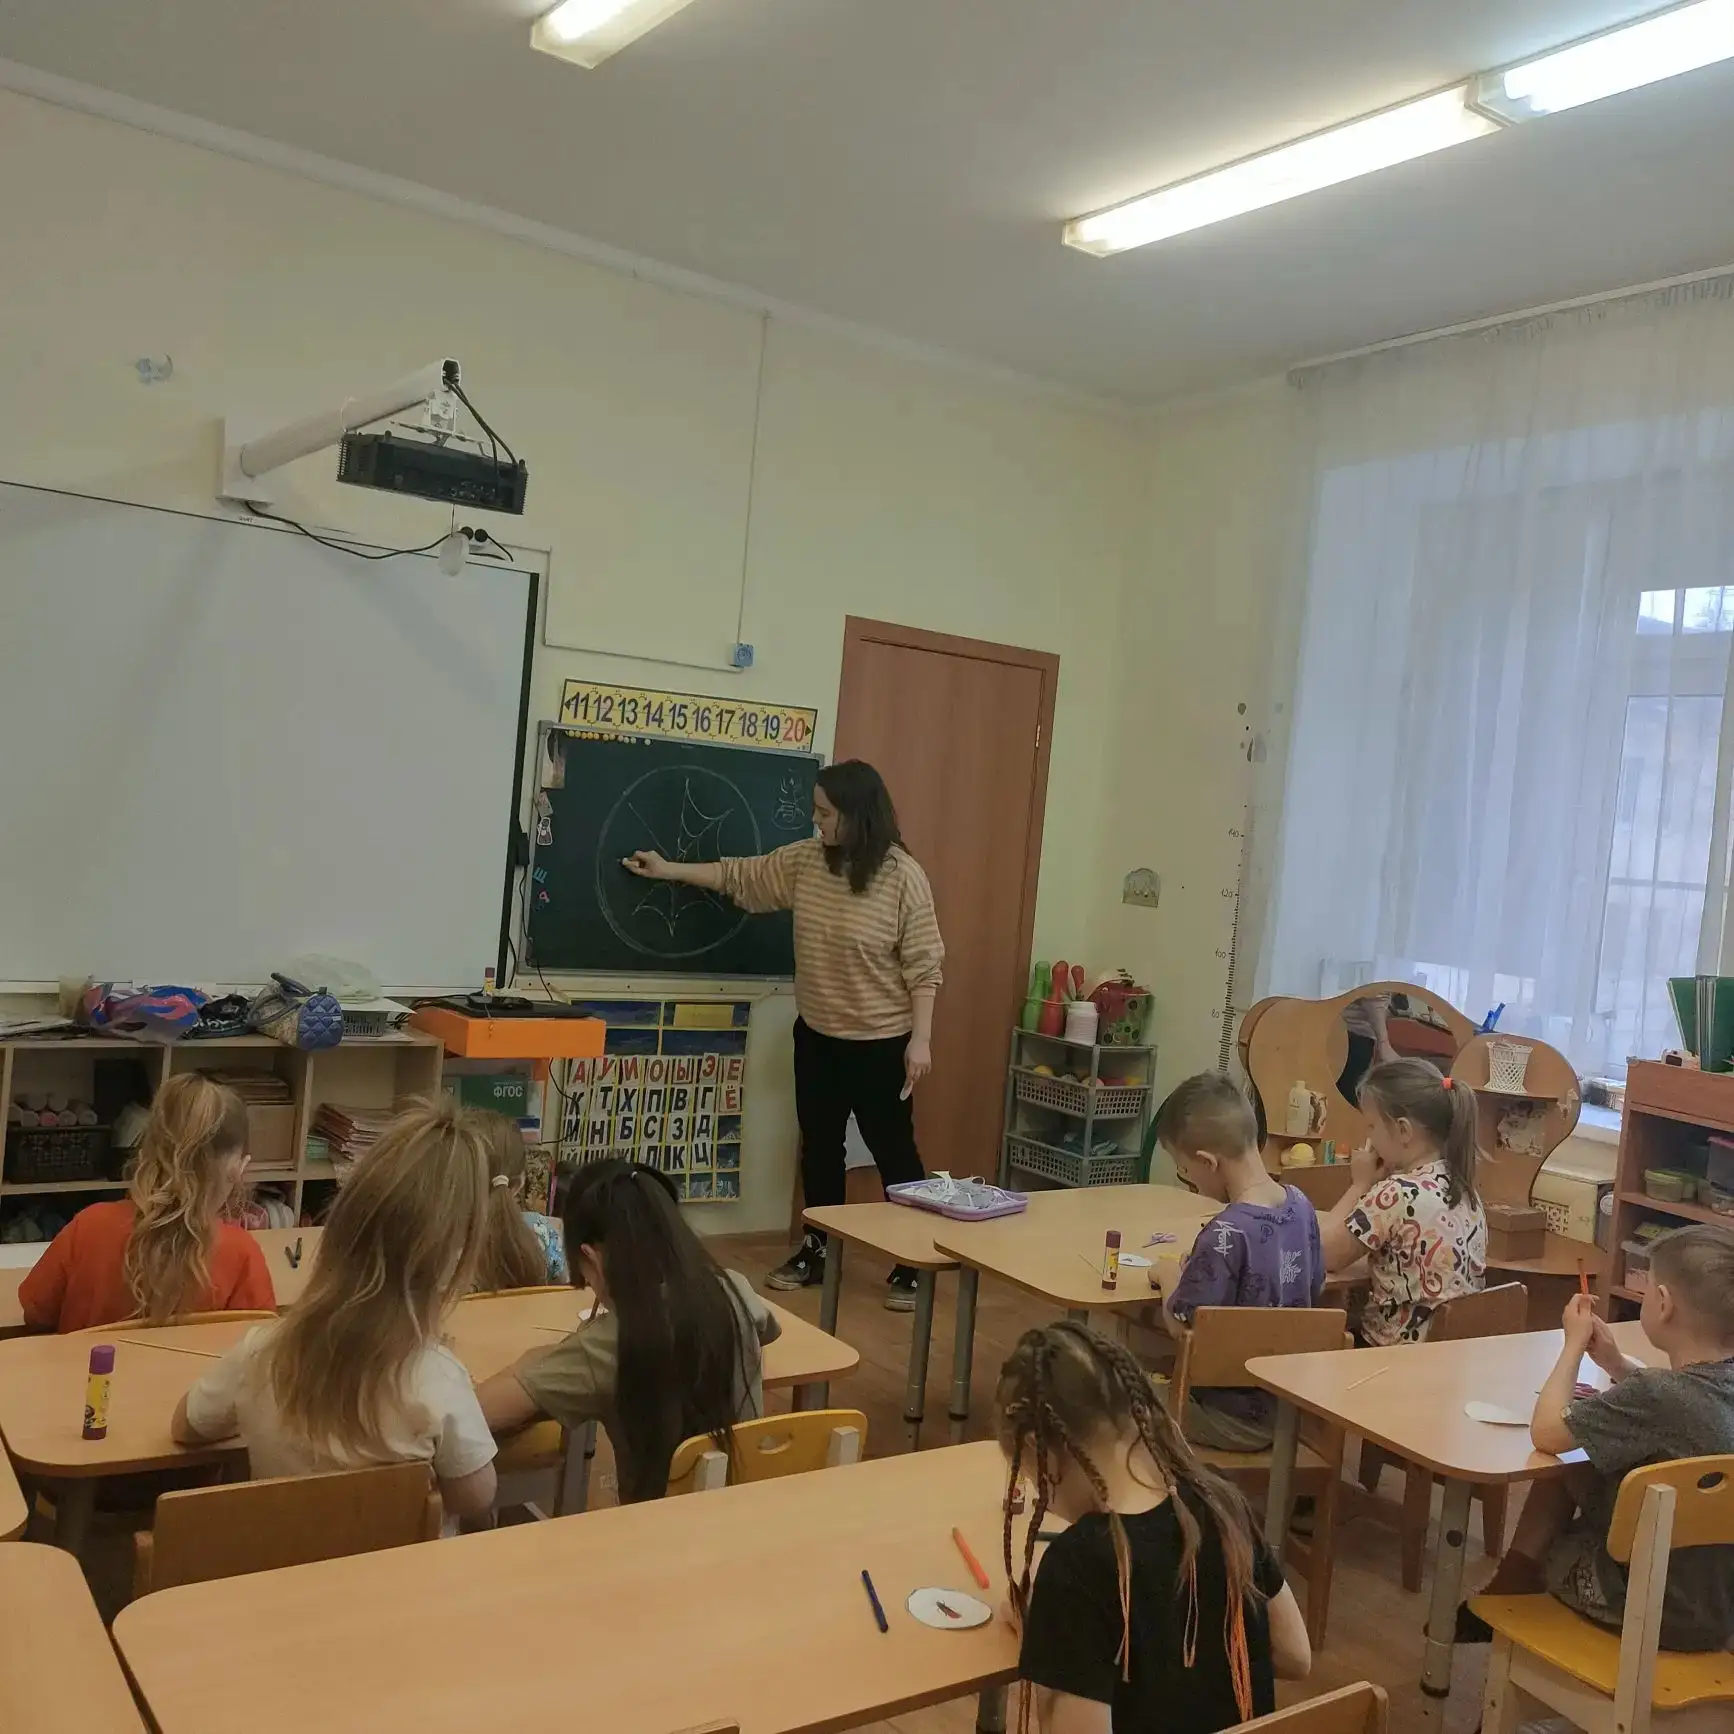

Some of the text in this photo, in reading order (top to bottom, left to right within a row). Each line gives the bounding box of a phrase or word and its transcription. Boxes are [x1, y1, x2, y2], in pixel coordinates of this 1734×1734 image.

[570, 691, 806, 742] 11 12 13 14 15 16 17 18 19 20
[1215, 947, 1227, 959] 100
[572, 1060, 586, 1084] А
[597, 1057, 615, 1081] У
[623, 1056, 639, 1081] И
[649, 1059, 664, 1082] О
[702, 1054, 716, 1078] Э
[727, 1058, 742, 1081] Е
[493, 1085, 524, 1098] ФГОС
[569, 1084, 737, 1115] К Т Х П В Г Ё
[590, 1120, 605, 1145] Н
[619, 1116, 634, 1140] Б
[643, 1115, 658, 1139] С
[671, 1117, 684, 1141] З
[696, 1114, 711, 1138] Д
[672, 1146, 686, 1169] К
[694, 1141, 709, 1166] Ц
